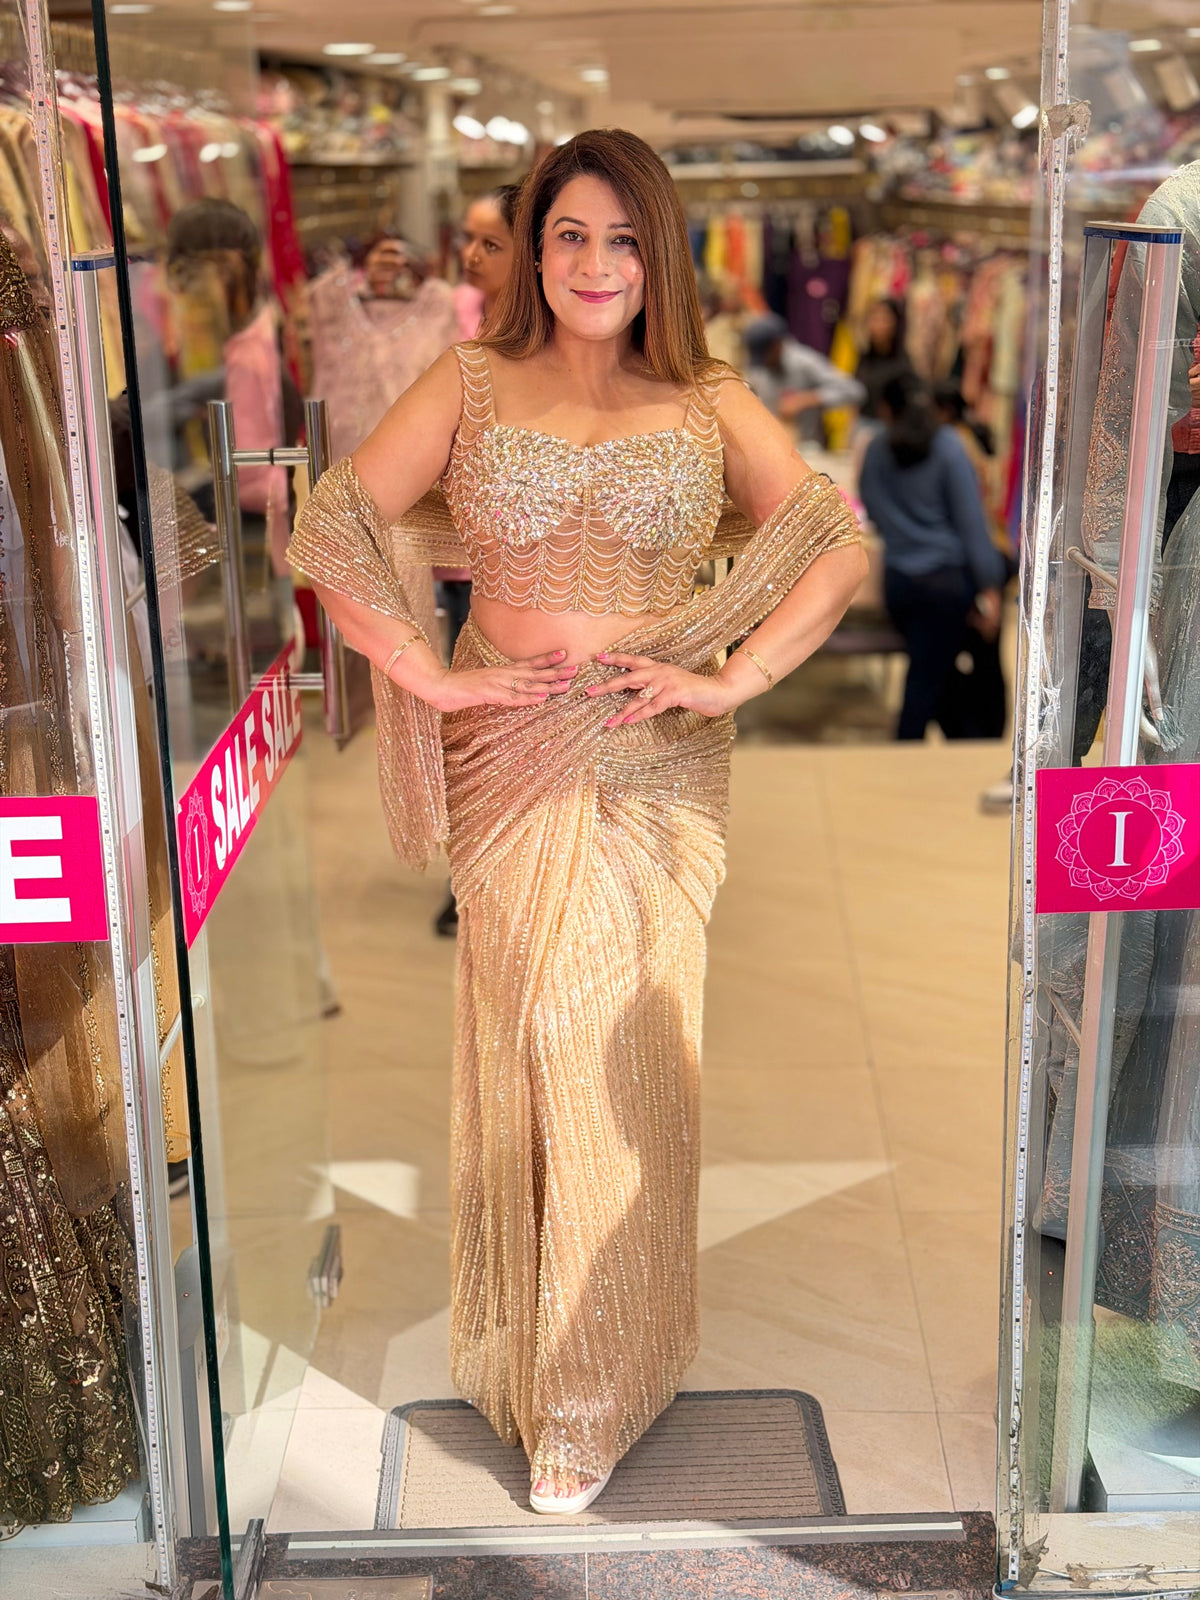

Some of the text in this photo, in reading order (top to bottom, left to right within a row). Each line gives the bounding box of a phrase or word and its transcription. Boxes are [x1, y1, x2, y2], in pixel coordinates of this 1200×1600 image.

[211, 711, 260, 870] SALE
[262, 650, 301, 782] SALE
[0, 815, 72, 924] E
[1106, 811, 1134, 867] I
